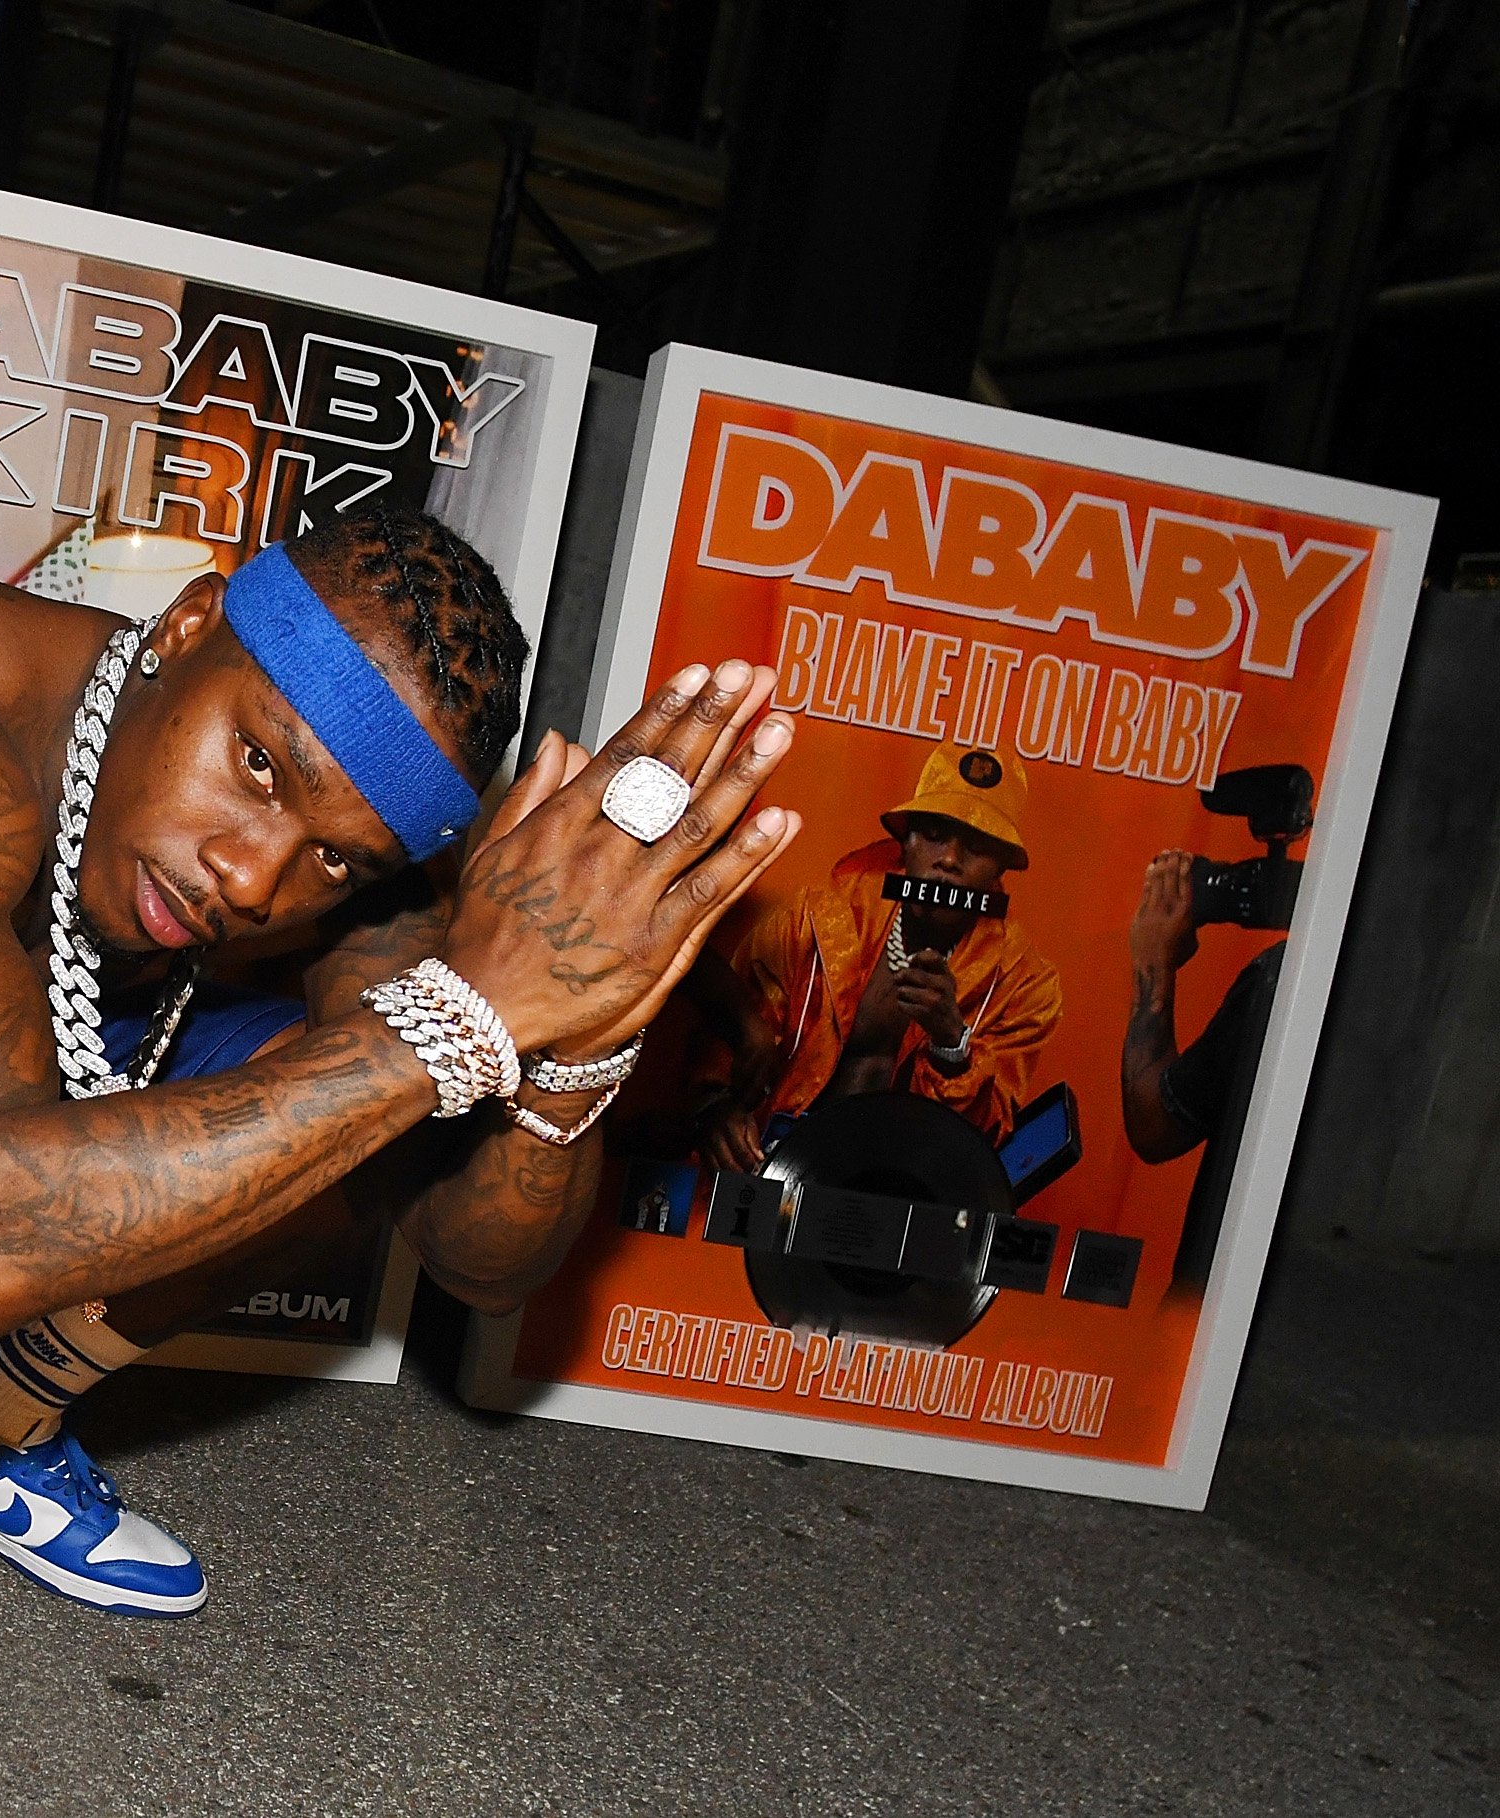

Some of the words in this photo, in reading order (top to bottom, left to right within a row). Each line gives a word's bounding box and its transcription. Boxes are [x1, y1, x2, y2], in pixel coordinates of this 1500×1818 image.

[696, 422, 1368, 680] DABABY
[771, 605, 963, 740] BLAME
[953, 640, 1023, 750] IT
[1016, 654, 1099, 771] ON
[1095, 669, 1243, 792] BABY
[901, 879, 991, 912] DELUXE
[226, 1291, 350, 1322] BUM
[602, 1303, 796, 1393] CERTIFIED
[795, 1332, 985, 1420] PLATINUM
[982, 1361, 1114, 1438] ALBUM
